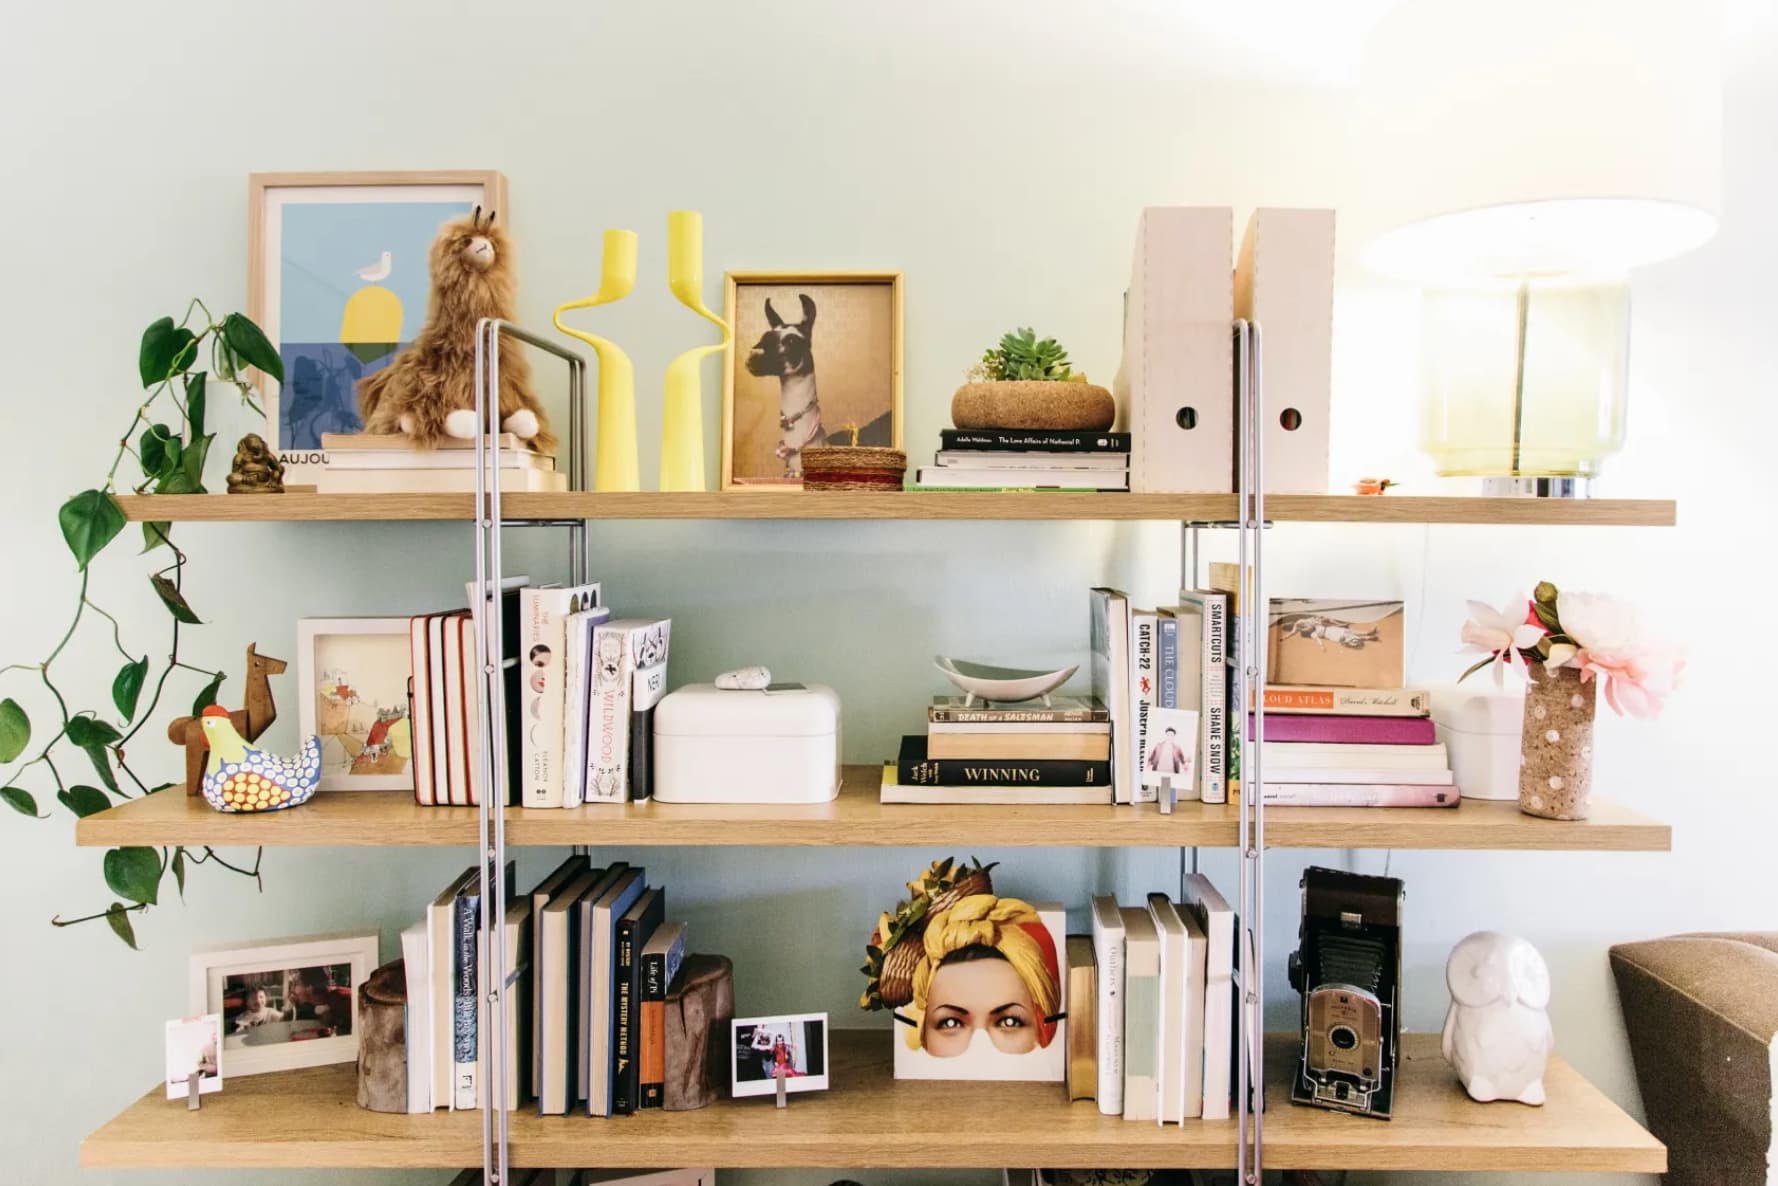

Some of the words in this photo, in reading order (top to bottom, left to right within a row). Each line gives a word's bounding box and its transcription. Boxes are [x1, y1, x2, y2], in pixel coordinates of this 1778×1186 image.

[998, 435, 1010, 445] The
[1010, 435, 1023, 445] Love
[1023, 436, 1042, 445] Affairs
[1043, 436, 1049, 445] of
[1210, 603, 1222, 664] SMARTCUTS
[1138, 623, 1151, 671] CATCH-22
[1164, 644, 1176, 665] THE
[1164, 668, 1176, 708] CLOUD
[1297, 694, 1332, 706] ATLAS
[601, 689, 616, 764] WILDWOOD
[956, 712, 988, 722] DEATH
[1004, 712, 1054, 722] SALESMAN
[1209, 706, 1222, 740] SHANE
[1209, 742, 1222, 775] SNOW
[964, 766, 1041, 782] WINNING
[462, 917, 474, 941] Walk
[462, 962, 473, 996] Woods
[647, 977, 658, 985] of
[649, 961, 658, 977] Life
[620, 982, 629, 995] THE
[649, 985, 658, 994] Pi
[619, 996, 629, 1026] MYSTERY
[619, 1027, 628, 1056] METHOD
